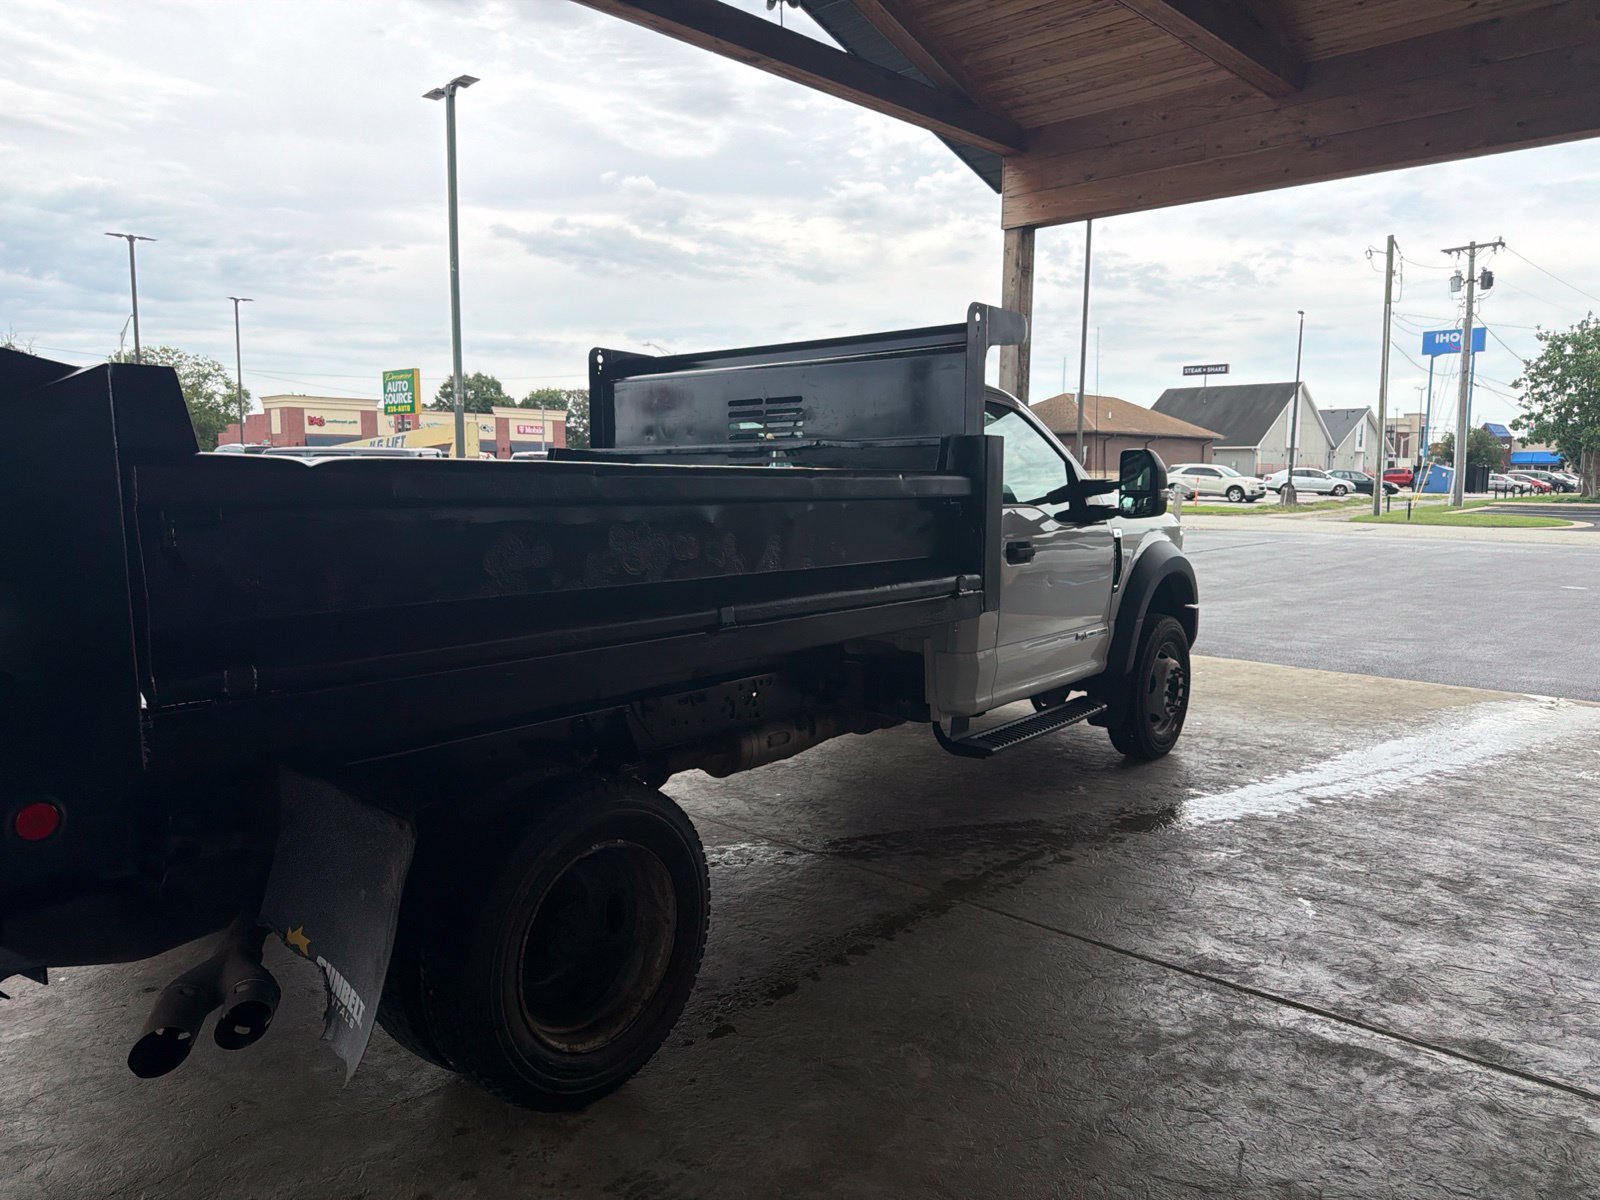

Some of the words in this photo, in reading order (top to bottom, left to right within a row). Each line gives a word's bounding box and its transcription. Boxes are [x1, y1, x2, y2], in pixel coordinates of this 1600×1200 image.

[1435, 332, 1462, 344] IHO
[386, 380, 408, 393] AUTO
[385, 392, 413, 405] SOURCE
